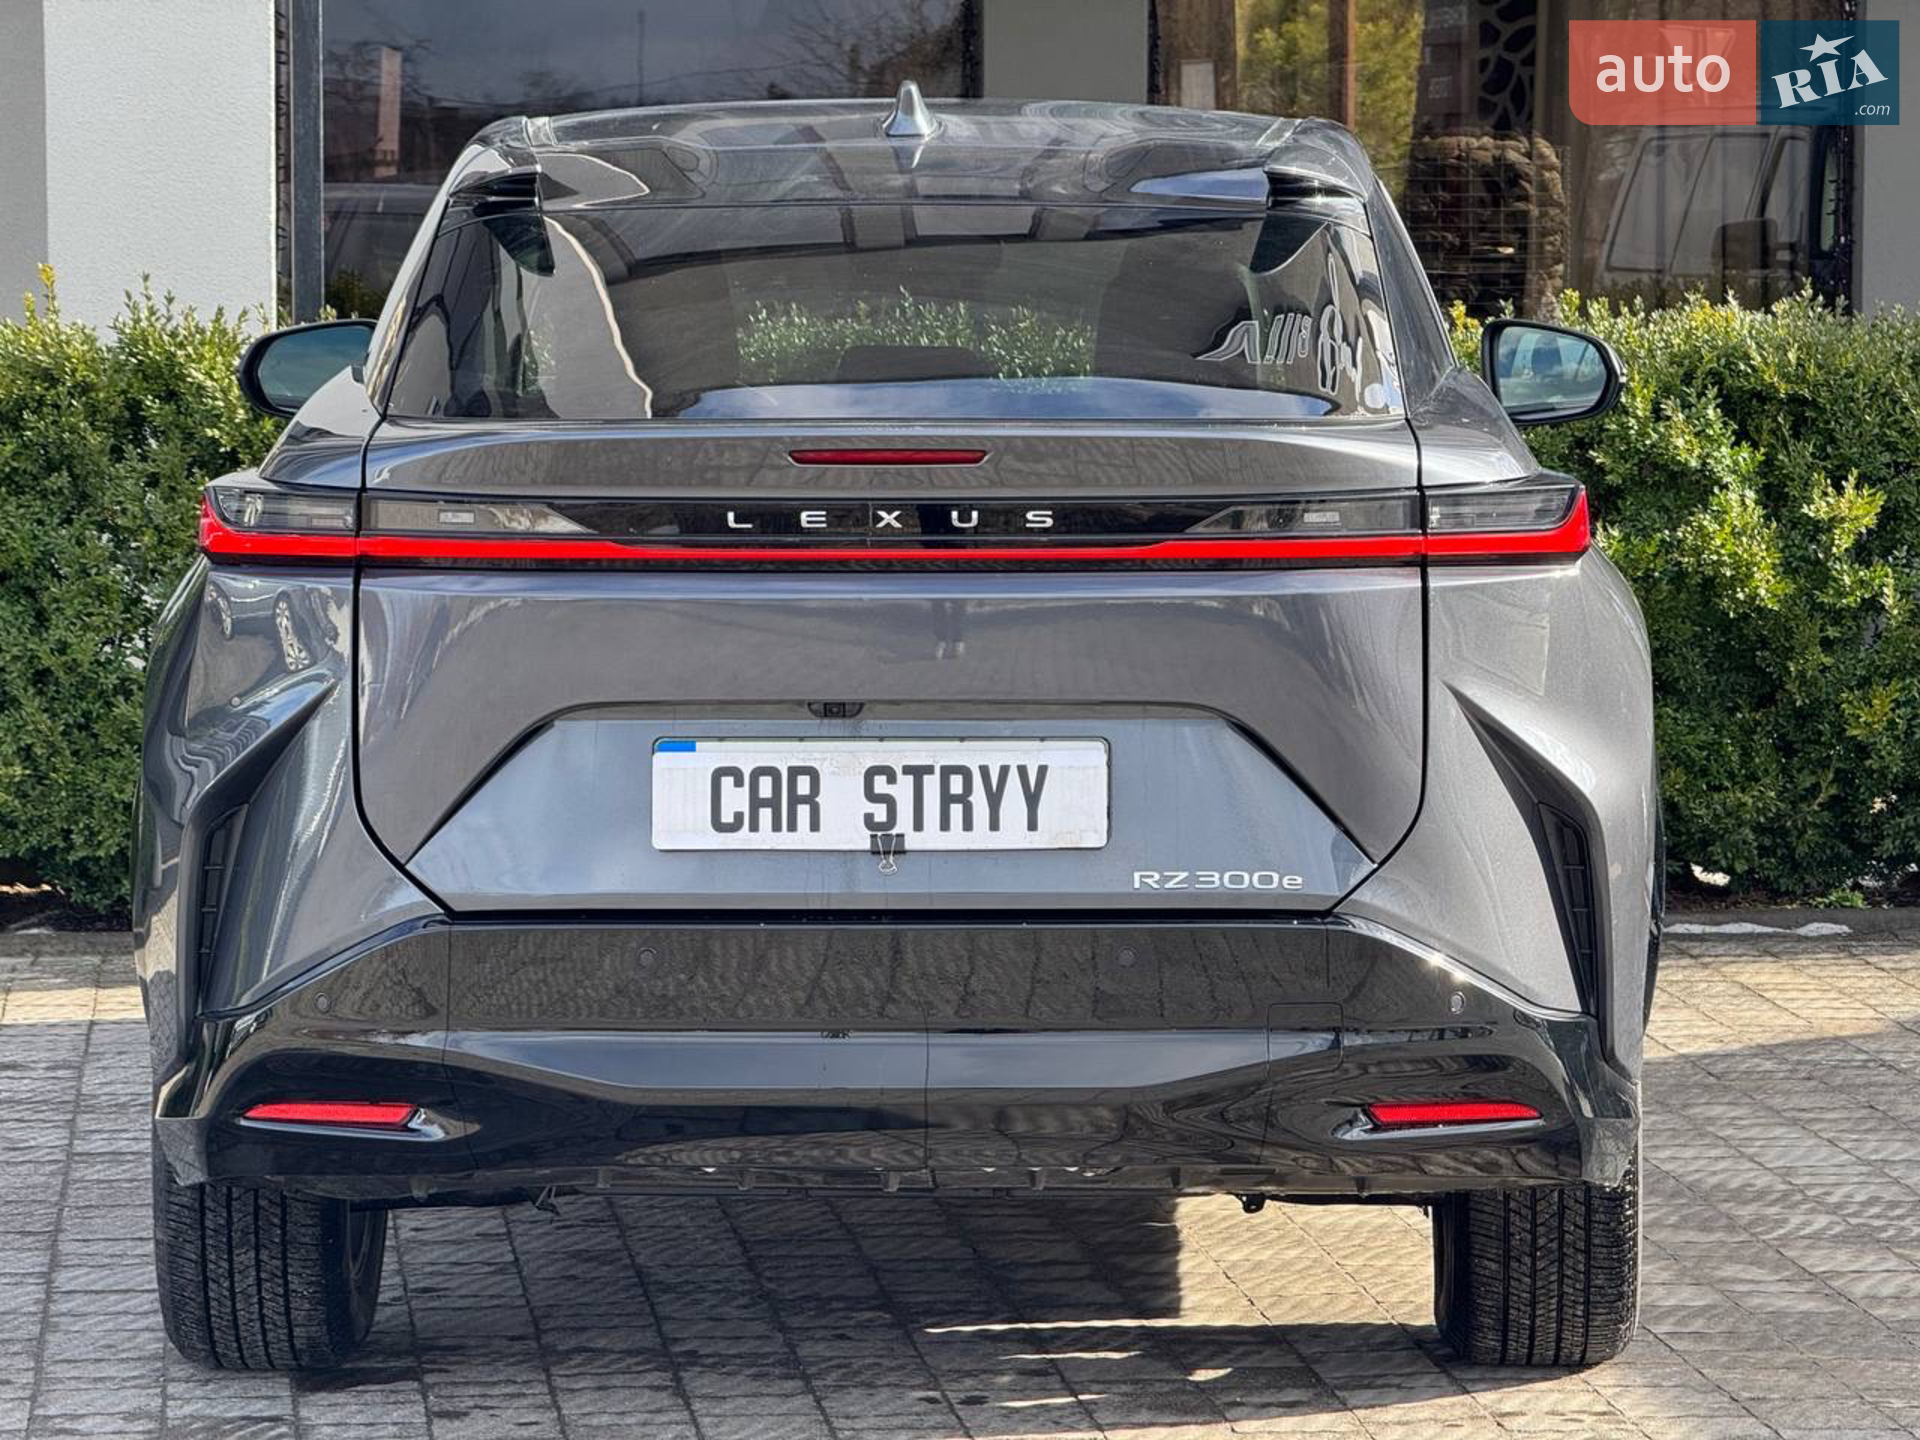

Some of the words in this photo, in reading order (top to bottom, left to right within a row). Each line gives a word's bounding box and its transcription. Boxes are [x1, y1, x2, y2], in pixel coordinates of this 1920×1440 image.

[726, 510, 1055, 529] LEXUS
[710, 765, 821, 833] CAR
[863, 764, 1048, 832] STRYY
